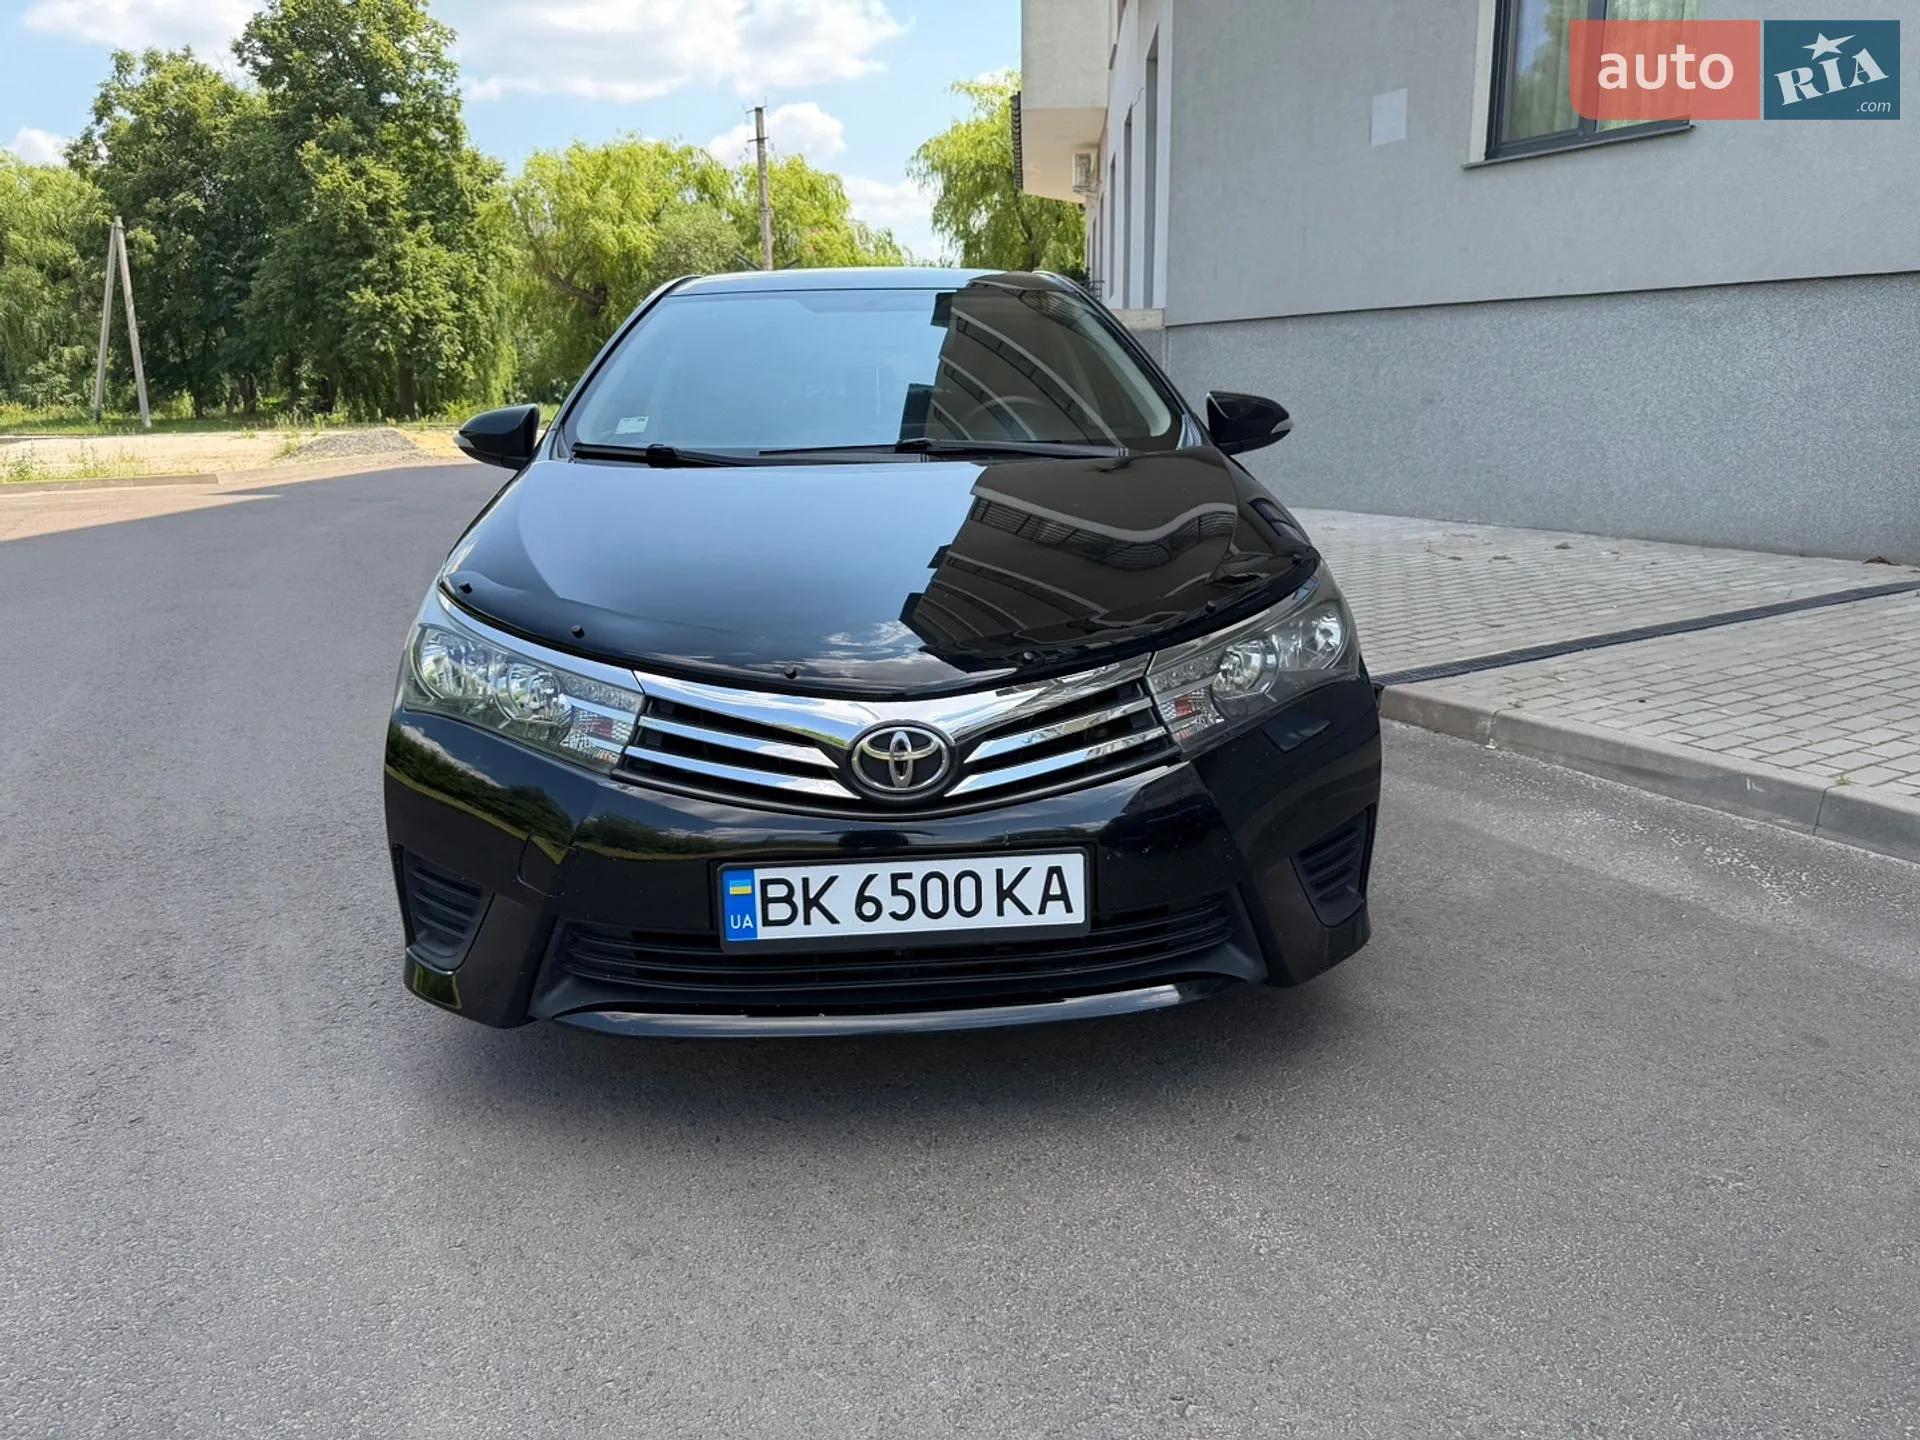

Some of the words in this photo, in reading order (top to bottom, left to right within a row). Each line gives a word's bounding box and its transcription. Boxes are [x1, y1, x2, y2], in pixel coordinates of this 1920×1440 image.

[759, 874, 841, 928] BK
[855, 869, 983, 923] 6500
[995, 865, 1074, 917] KA
[730, 914, 754, 930] UA
